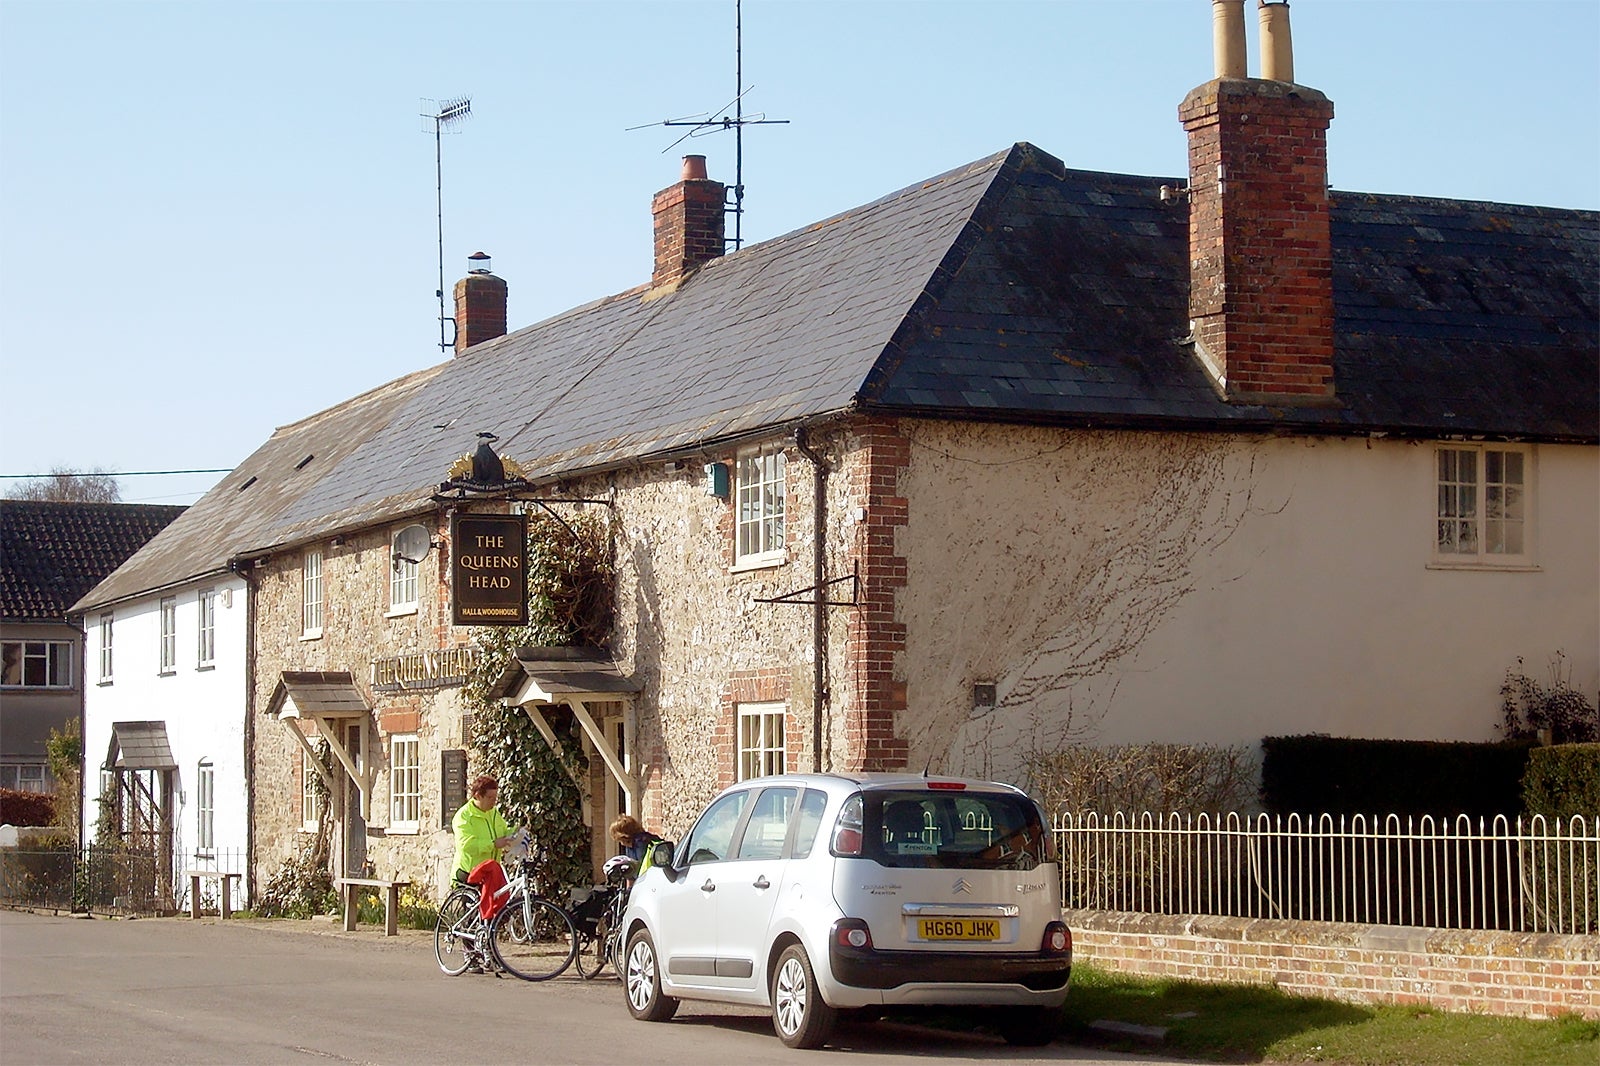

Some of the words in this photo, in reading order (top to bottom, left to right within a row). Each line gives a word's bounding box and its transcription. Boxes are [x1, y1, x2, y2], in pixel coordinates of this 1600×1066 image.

[475, 535, 504, 548] THE
[460, 555, 519, 570] QUEENS
[469, 576, 511, 589] HEAD
[370, 658, 393, 686] THE
[394, 653, 438, 690] QUEENS
[440, 648, 473, 679] HEAD
[925, 922, 963, 936] HG60
[968, 922, 995, 937] JHK
